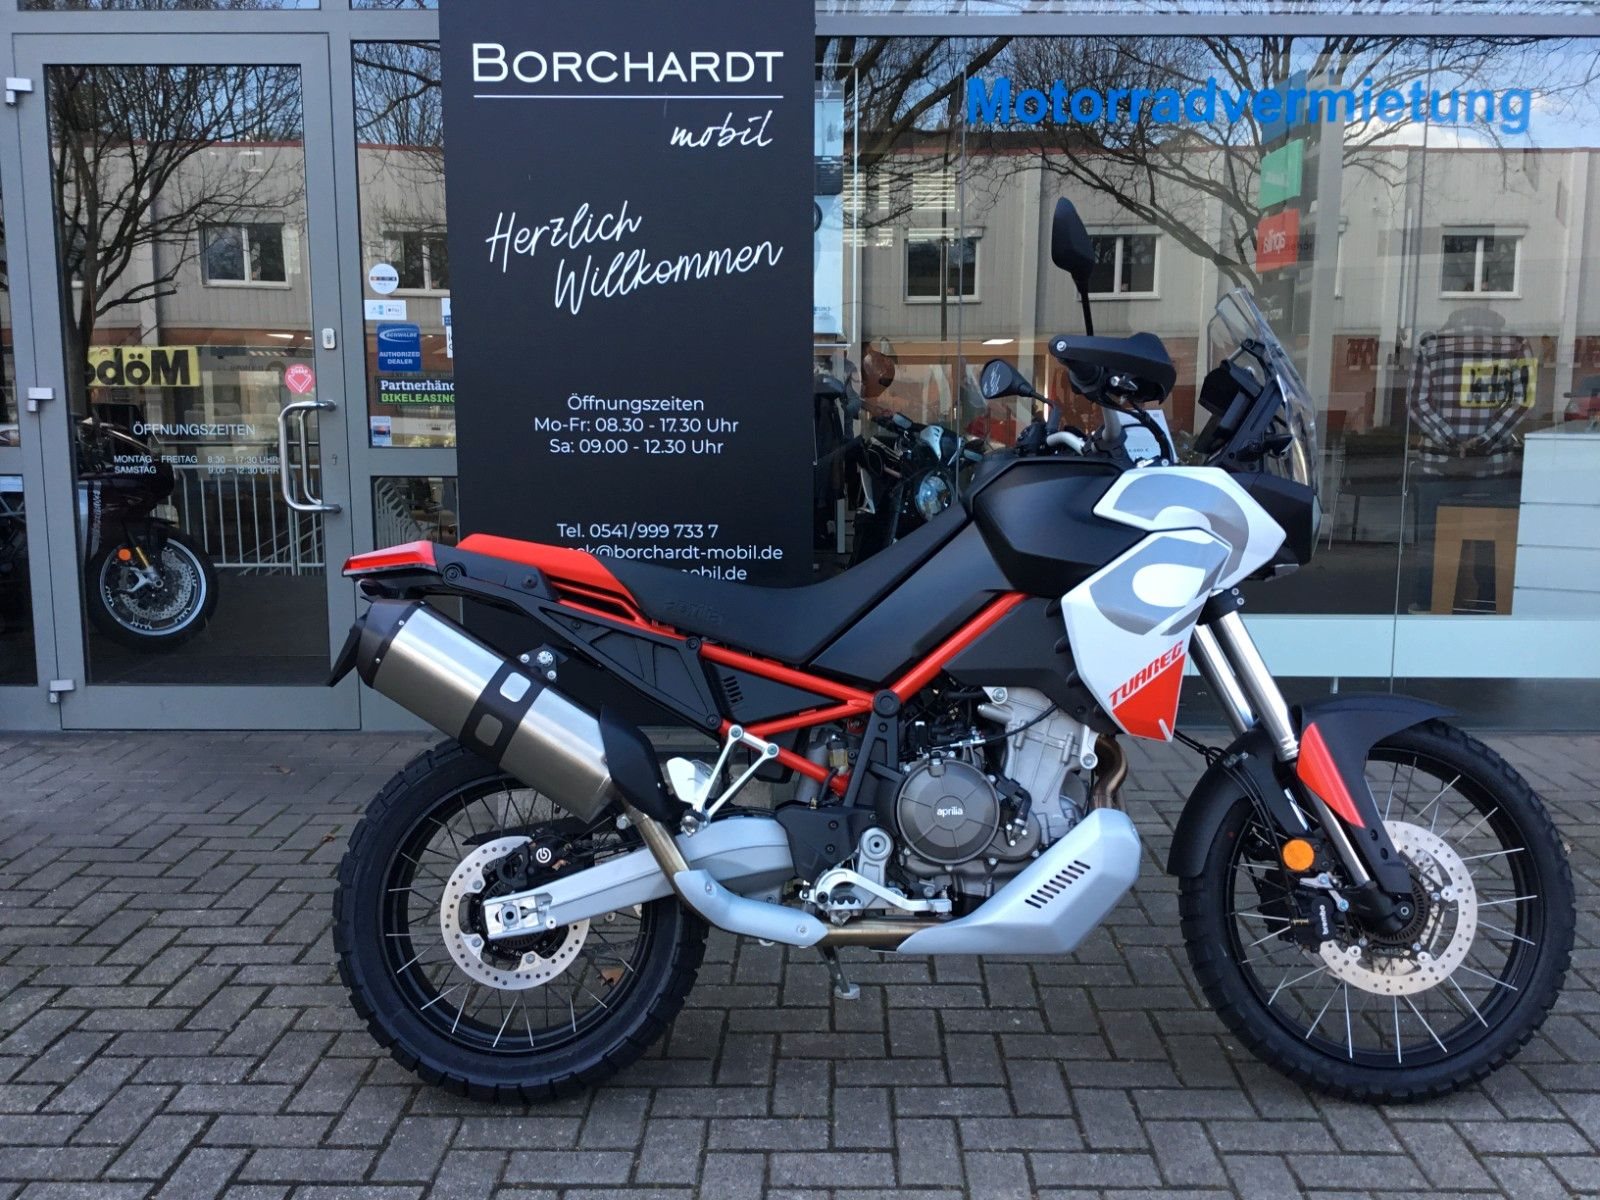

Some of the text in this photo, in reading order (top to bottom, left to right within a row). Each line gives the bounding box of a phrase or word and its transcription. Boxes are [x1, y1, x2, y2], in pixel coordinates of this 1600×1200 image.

[472, 43, 784, 83] BORCHARDT
[966, 76, 1532, 134] Motorradvermietung
[670, 110, 773, 147] mobil
[486, 200, 642, 273] Herzlich
[554, 240, 784, 315] Willkommen
[568, 393, 704, 414] Öffnungszeiten
[133, 421, 255, 436] ÖFFNUNGSZEITEN
[534, 417, 591, 432] Mo-Fr:
[595, 418, 644, 433] 08.30
[660, 417, 702, 433] 17.30
[706, 417, 739, 433] Uhr
[549, 438, 575, 454] Sa:
[579, 439, 629, 454] 09.00
[644, 439, 687, 454] 12.30
[691, 439, 724, 454] Uhr
[114, 455, 153, 464] MONTAG
[161, 455, 198, 464] FREITAG
[259, 455, 279, 464] UHR
[114, 466, 157, 474] SAMSTAG
[556, 521, 719, 540] Tel. 0541/999 733 7
[1109, 640, 1184, 707] TUAREG
[936, 806, 964, 818] aprilia
[1319, 904, 1329, 936] brembo
